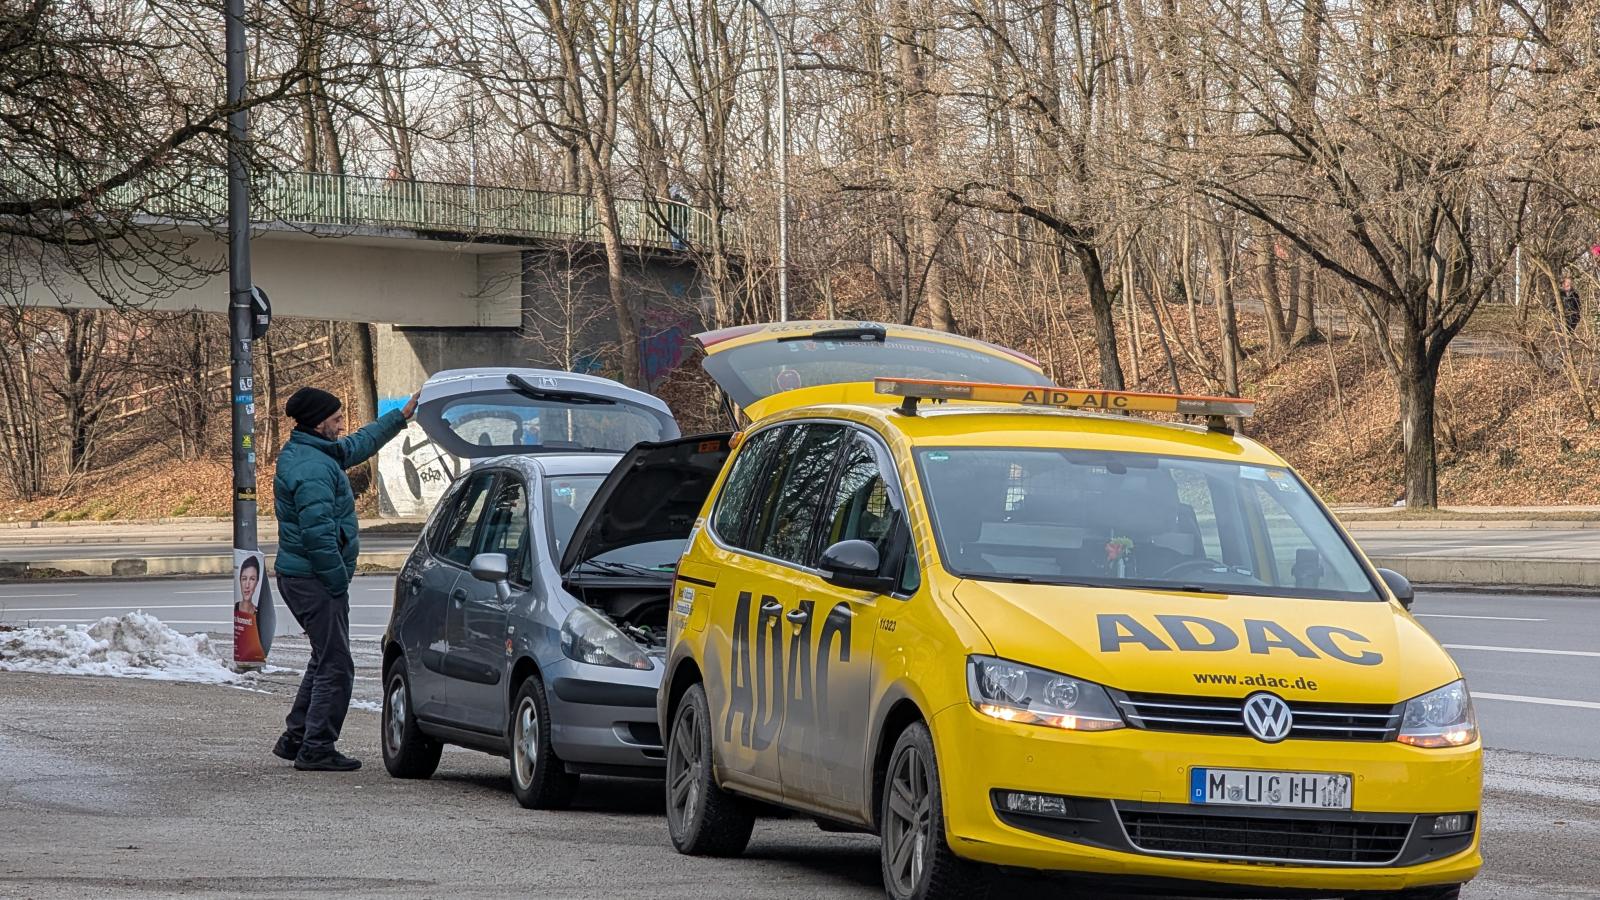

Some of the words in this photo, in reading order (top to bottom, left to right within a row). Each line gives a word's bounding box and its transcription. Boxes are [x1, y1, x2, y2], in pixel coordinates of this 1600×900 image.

[1021, 390, 1129, 408] ADAC
[879, 617, 897, 633] 11323
[1096, 613, 1384, 666] ADAC
[723, 590, 853, 752] ADAC
[1193, 672, 1318, 691] www.adac.de
